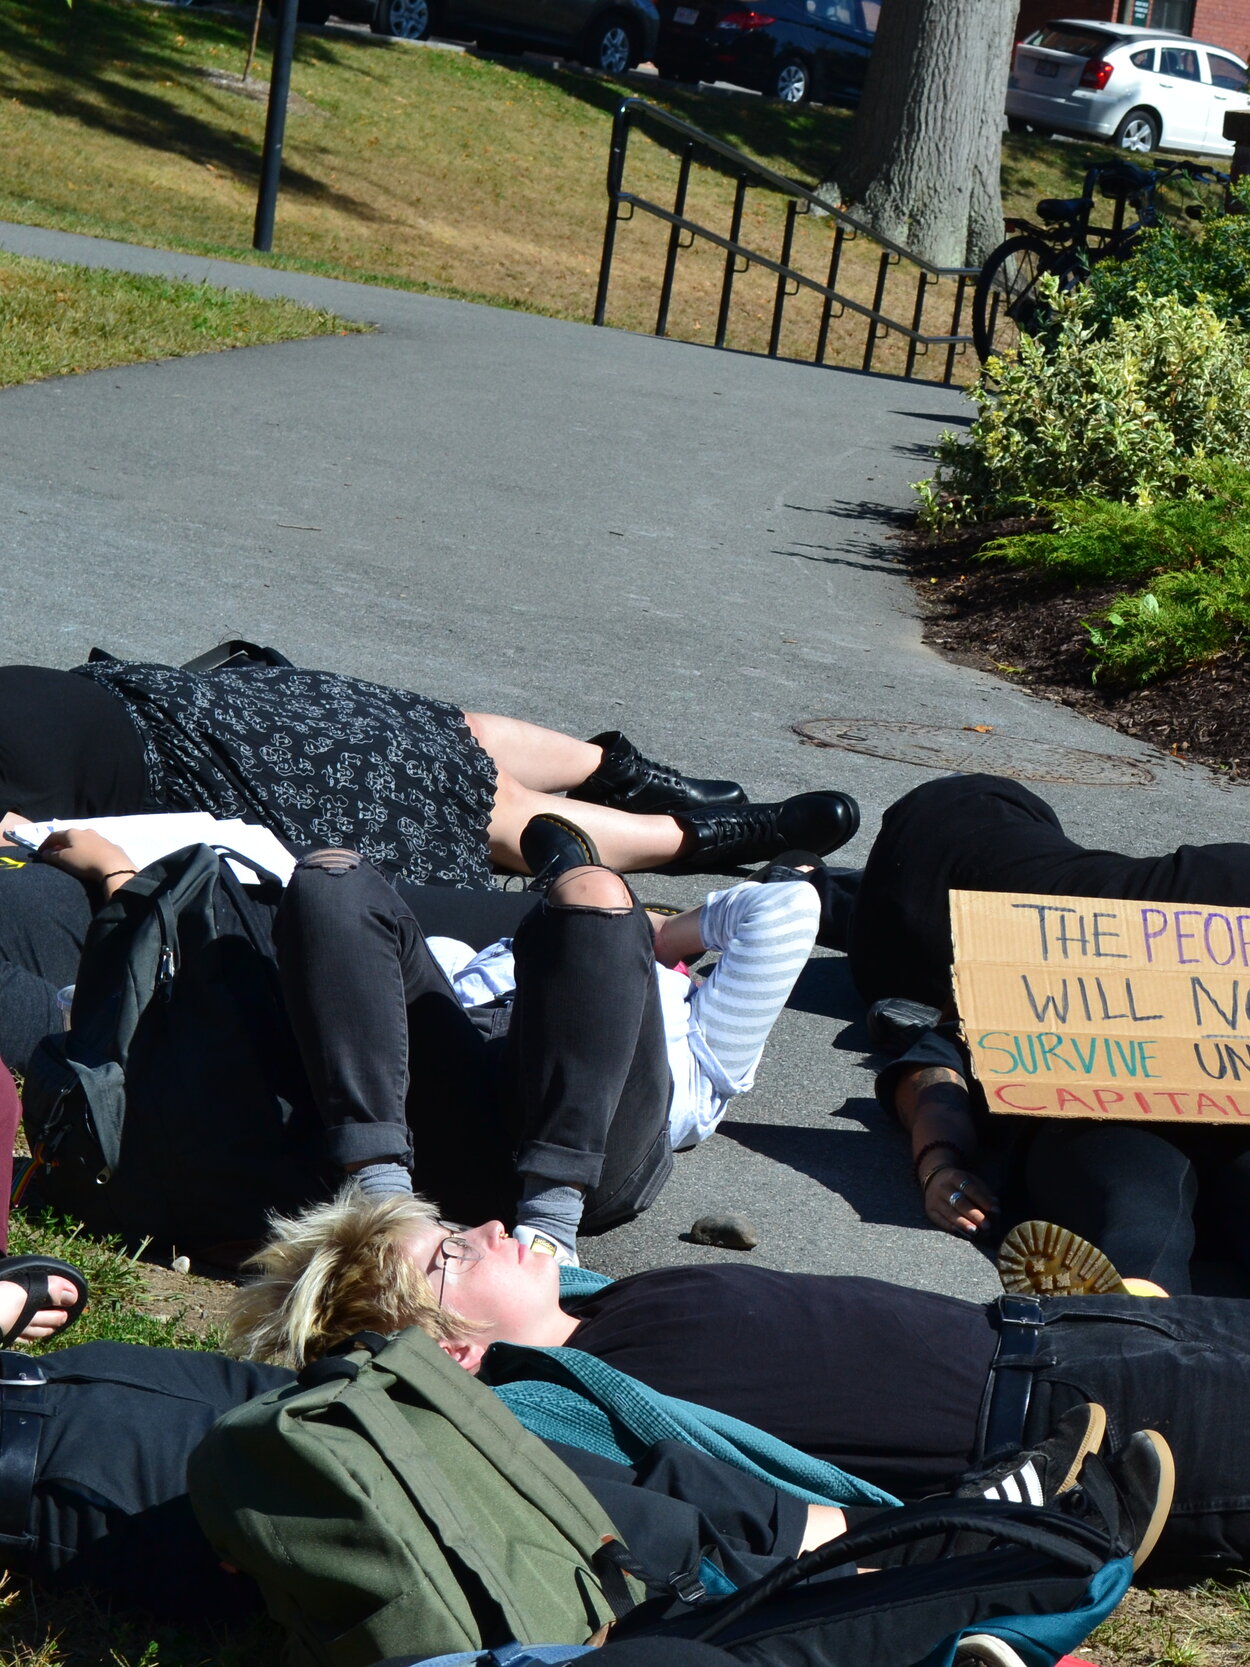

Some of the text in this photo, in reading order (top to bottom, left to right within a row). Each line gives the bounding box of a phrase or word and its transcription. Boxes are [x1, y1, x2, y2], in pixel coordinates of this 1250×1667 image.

[1011, 903, 1130, 961] THE
[1020, 974, 1164, 1024] WILL
[977, 1031, 1162, 1079] SURVIVE
